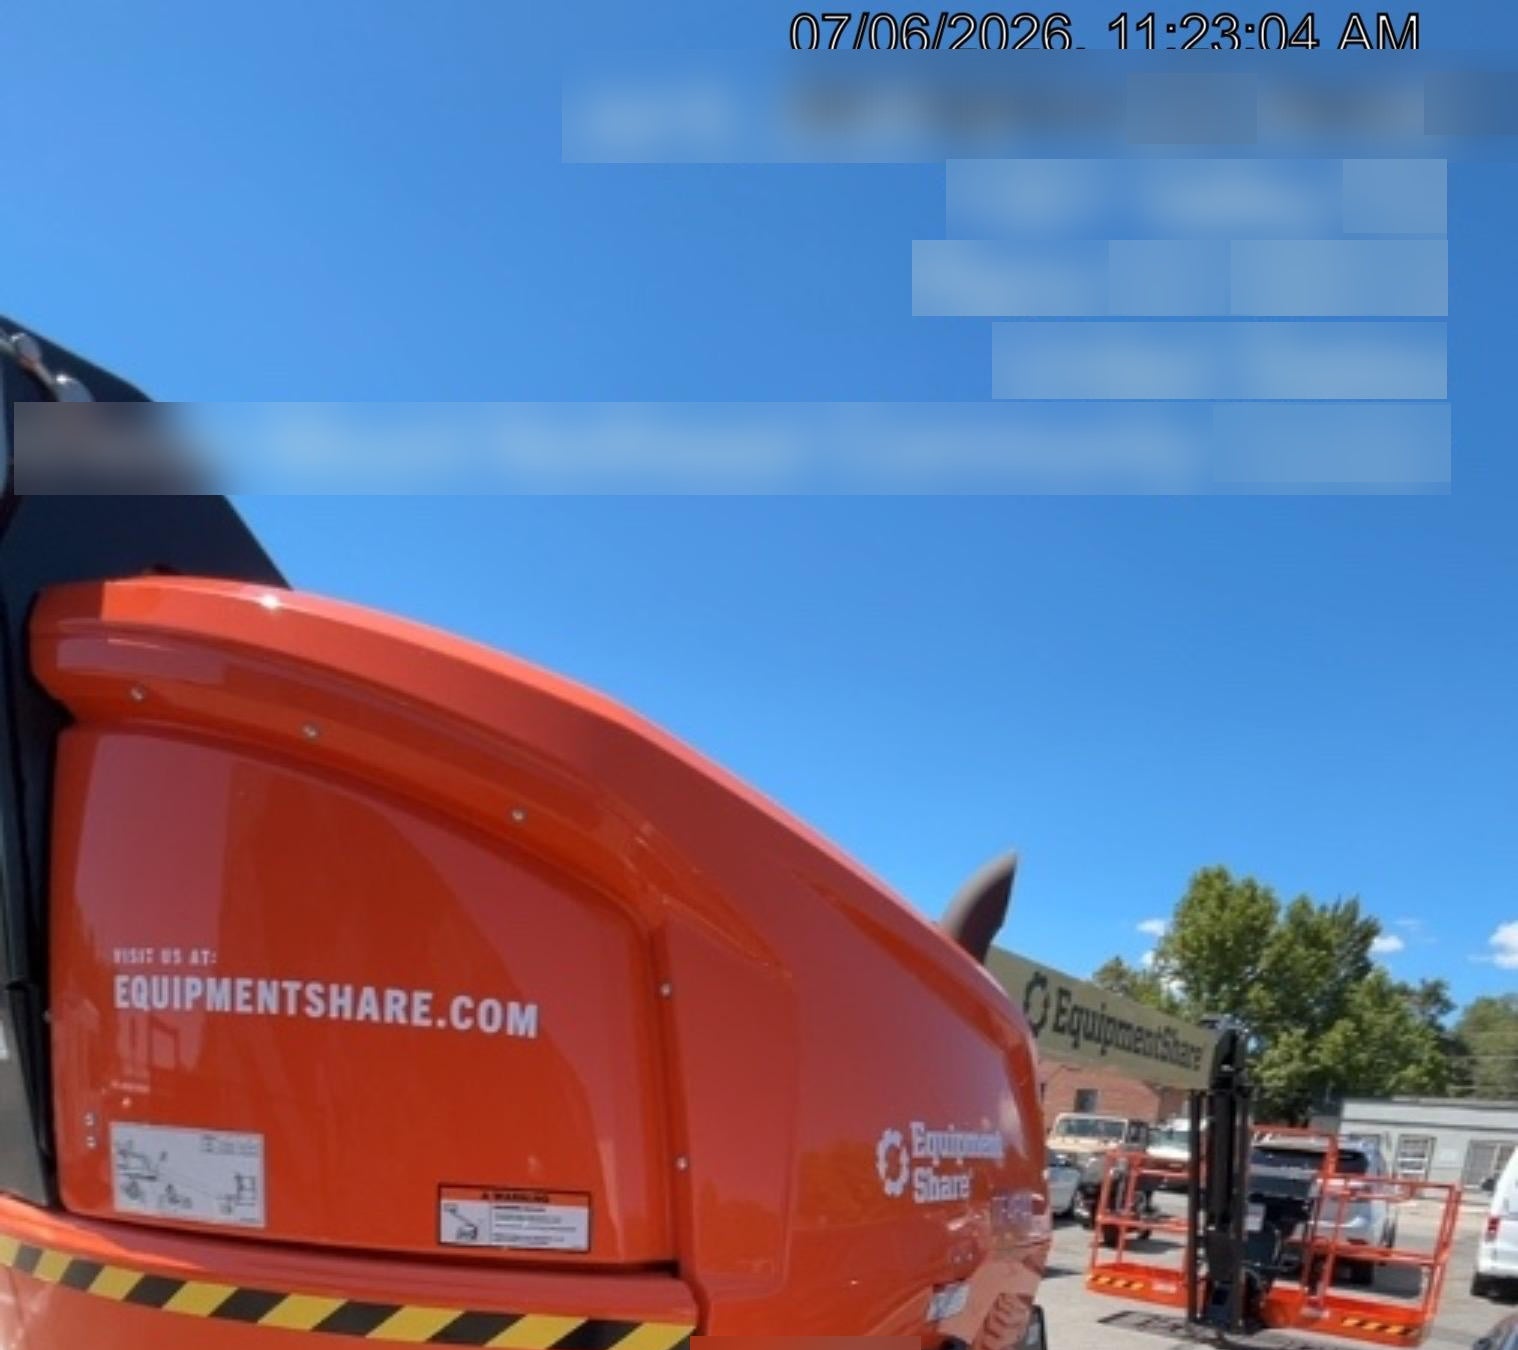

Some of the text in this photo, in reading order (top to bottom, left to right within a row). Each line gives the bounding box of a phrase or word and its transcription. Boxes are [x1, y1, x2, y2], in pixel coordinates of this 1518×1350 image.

[161, 948, 182, 965] US
[190, 948, 217, 966] AT:
[114, 974, 539, 1039] EQUIPMENTSHARE.COM
[1053, 986, 1202, 1071] EquipmentShare
[910, 1121, 1004, 1166] Equipment
[913, 1166, 970, 1204] Share
